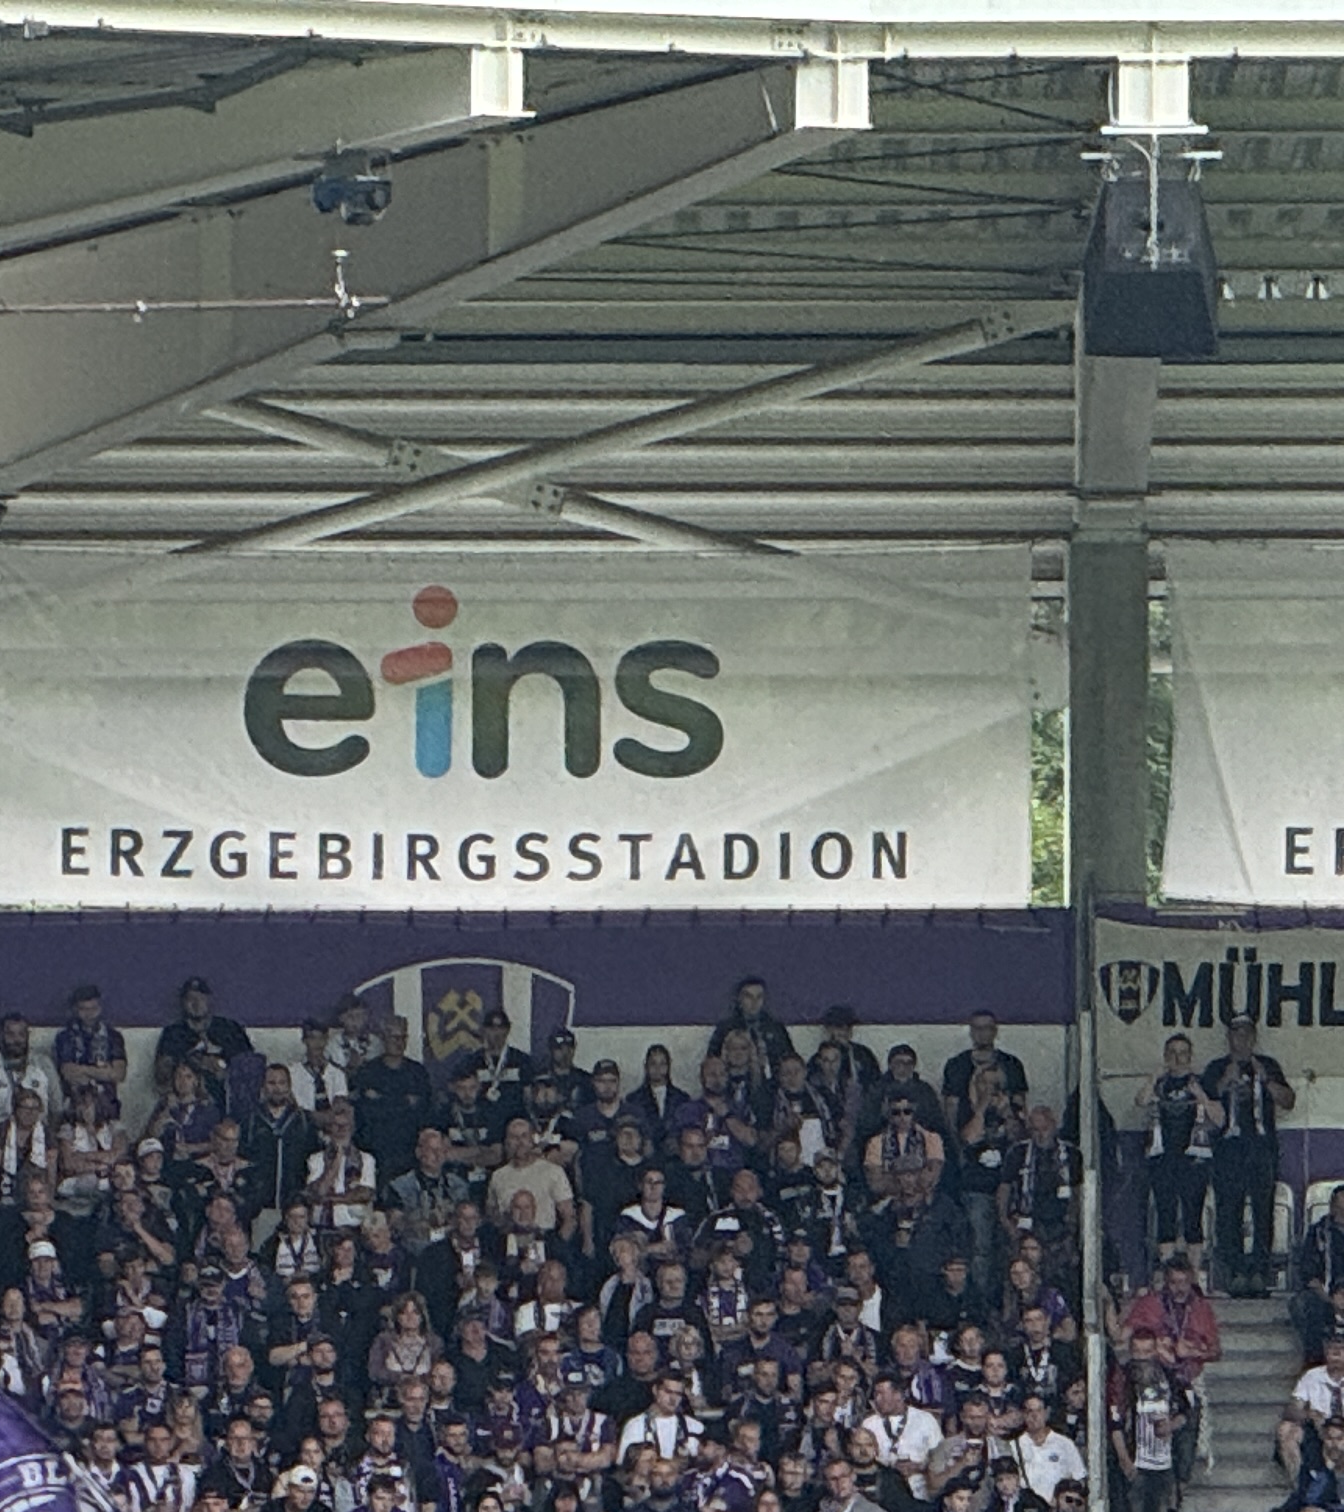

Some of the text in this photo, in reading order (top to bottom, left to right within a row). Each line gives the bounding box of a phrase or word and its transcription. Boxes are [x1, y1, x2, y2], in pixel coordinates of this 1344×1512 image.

[242, 585, 724, 780] eins
[60, 826, 910, 885] ERZGEBIRGSSTADION
[1285, 826, 1344, 876] E
[1162, 946, 1344, 1028] MÜHL
